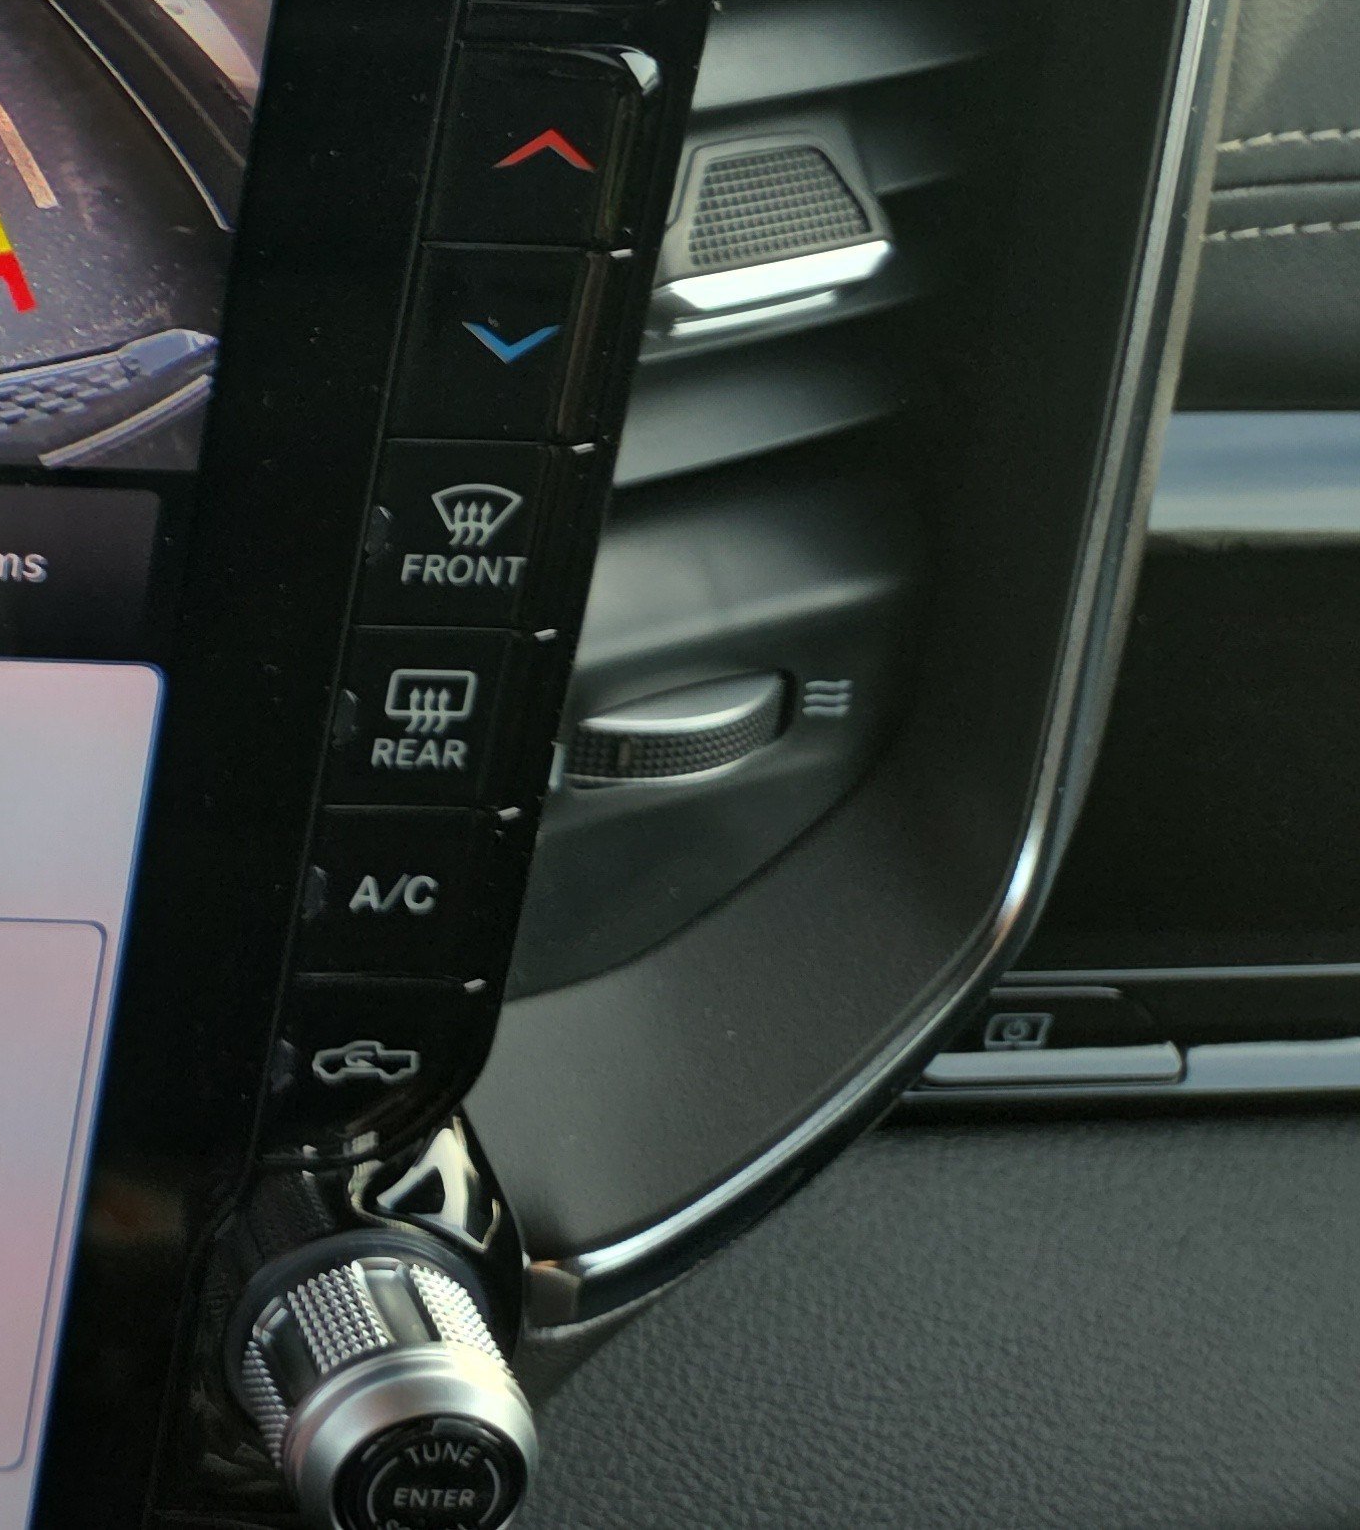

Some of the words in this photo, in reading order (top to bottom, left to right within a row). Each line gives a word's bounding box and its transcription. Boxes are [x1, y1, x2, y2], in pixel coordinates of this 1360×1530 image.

[401, 553, 528, 587] FRONT
[371, 737, 468, 769] REAR
[349, 873, 439, 914] A/C
[404, 1441, 481, 1467] TUNE
[393, 1487, 476, 1508] ENTER
